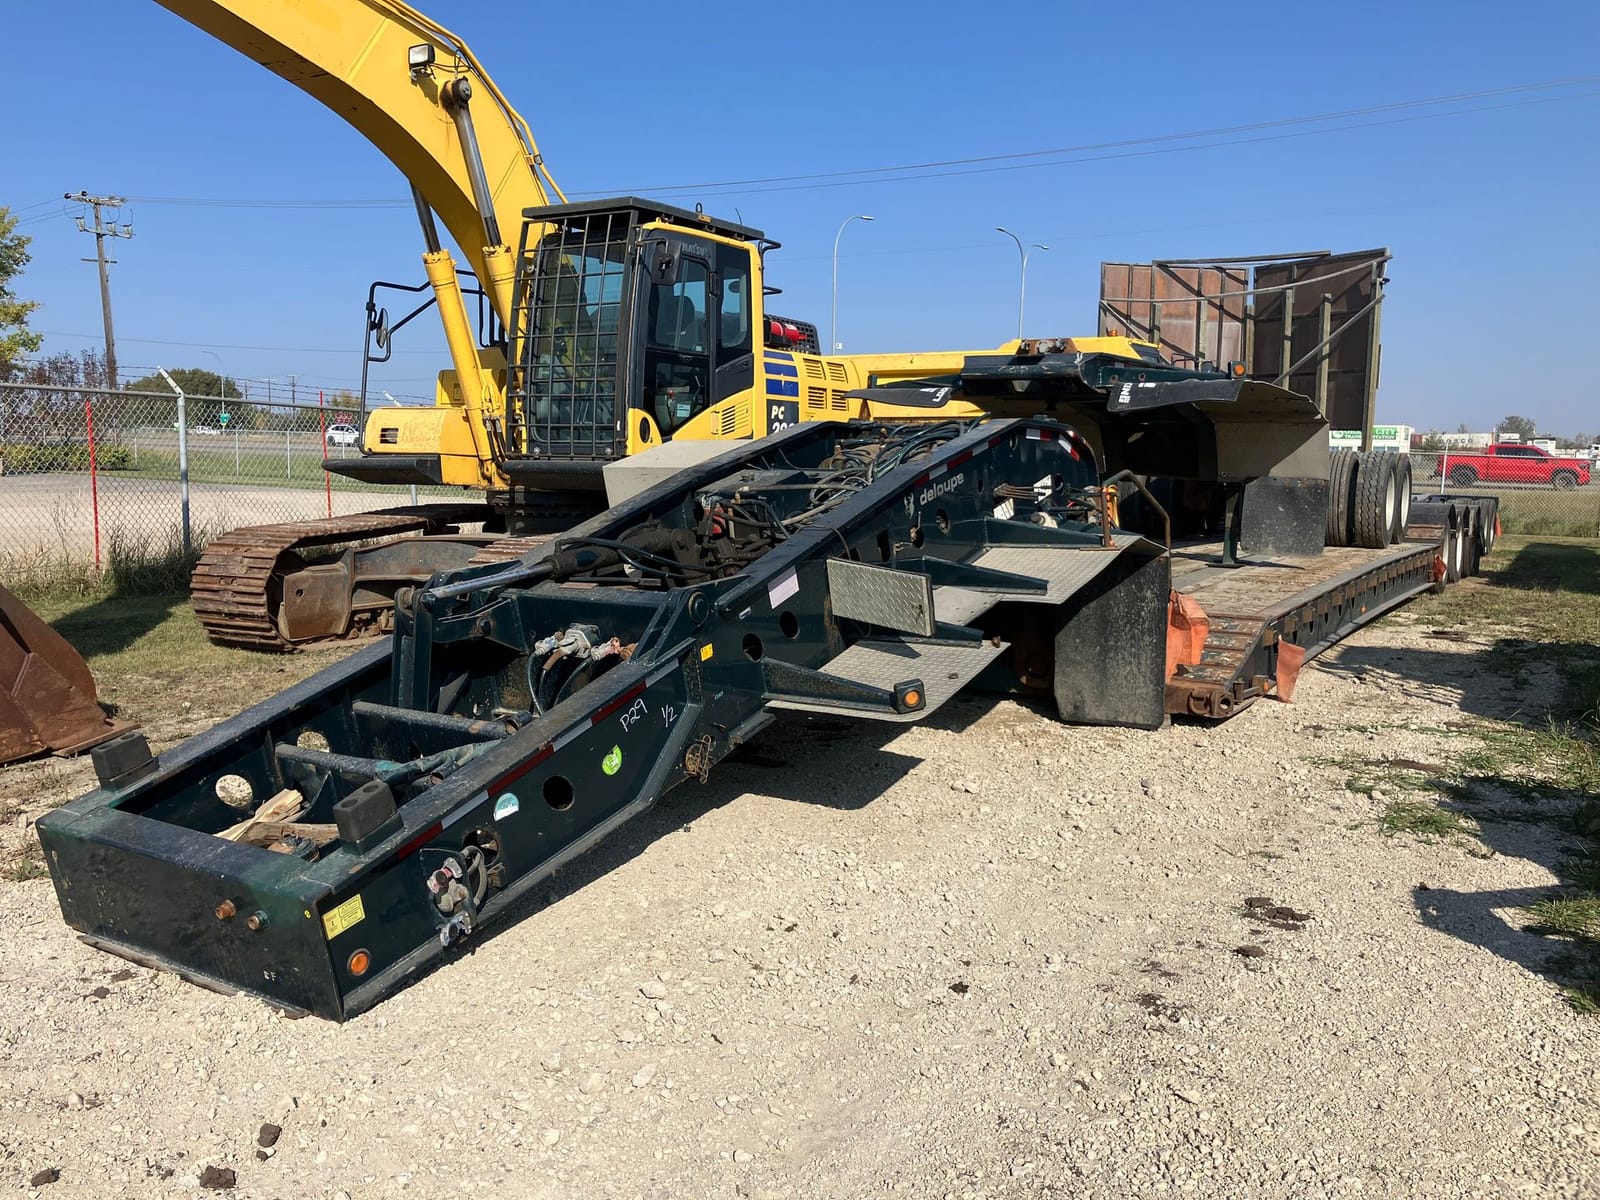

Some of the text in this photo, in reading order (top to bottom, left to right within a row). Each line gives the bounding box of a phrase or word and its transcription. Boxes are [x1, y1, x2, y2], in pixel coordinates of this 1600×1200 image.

[771, 405, 785, 420] PC
[919, 472, 965, 506] deloupe
[619, 698, 678, 733] P29 1/2
